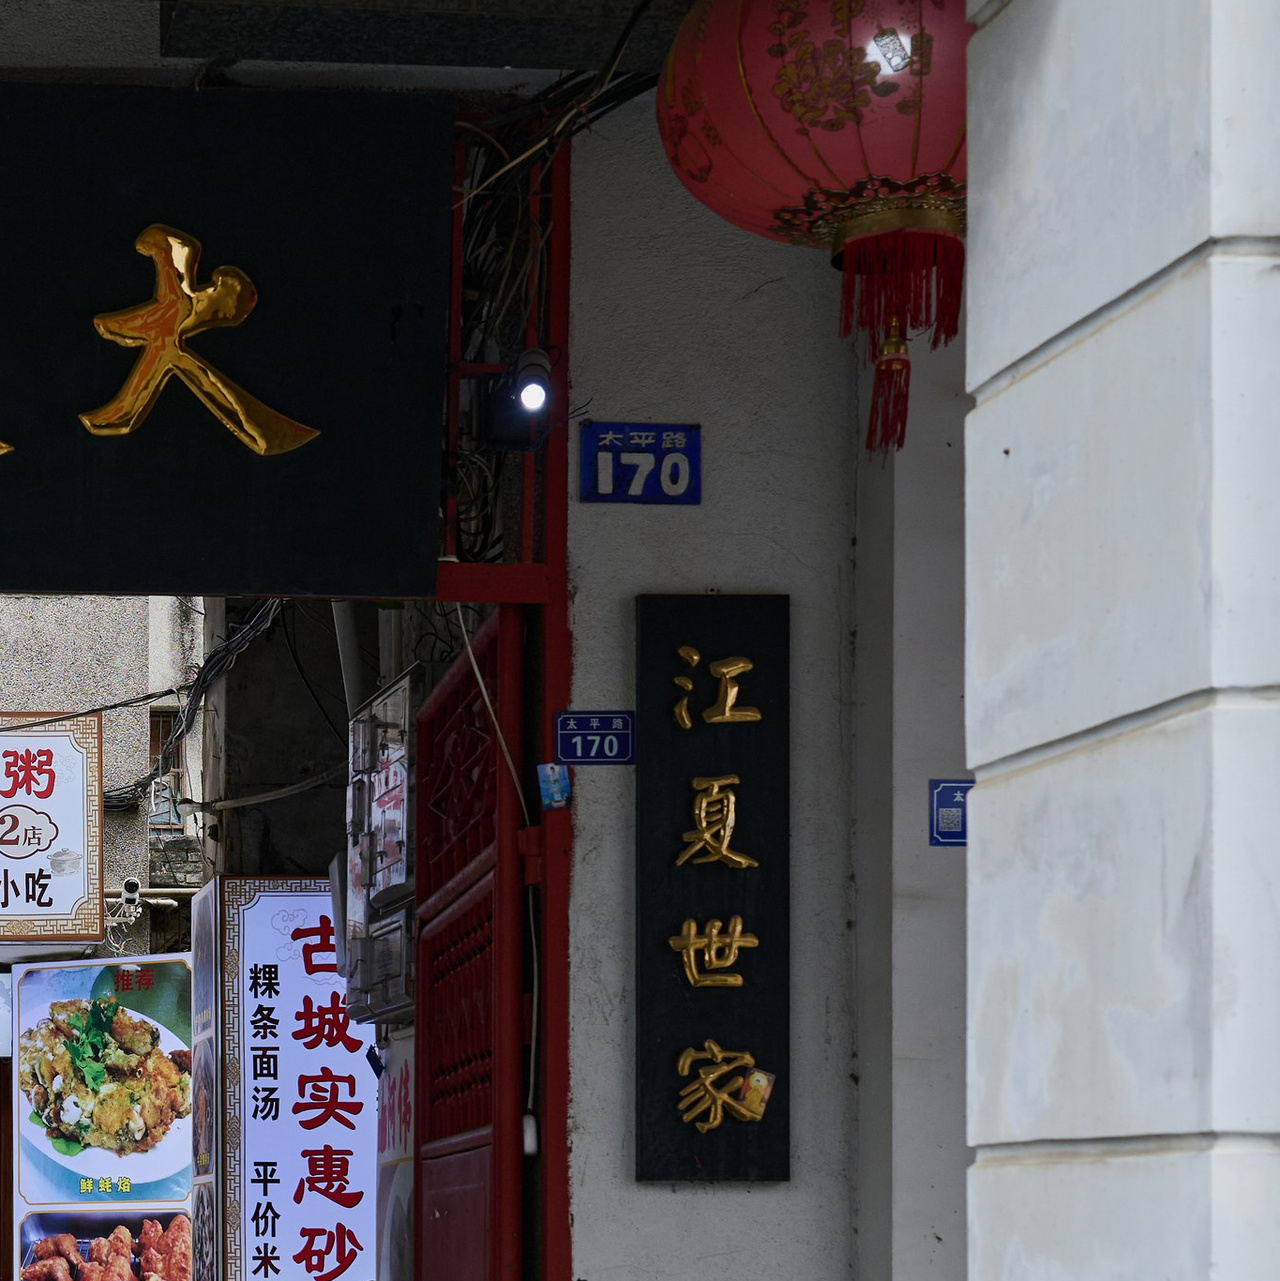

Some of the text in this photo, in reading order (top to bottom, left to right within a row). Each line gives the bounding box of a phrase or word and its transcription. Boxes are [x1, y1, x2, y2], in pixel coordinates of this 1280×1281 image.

[598, 430, 689, 449] 太平路
[597, 452, 691, 497] 170
[566, 718, 624, 730] 太平路
[571, 735, 619, 757] 170
[114, 968, 154, 993] 推荐
[249, 963, 281, 1122] 粿条面汤
[79, 1176, 133, 1194] 鲜蚝烙
